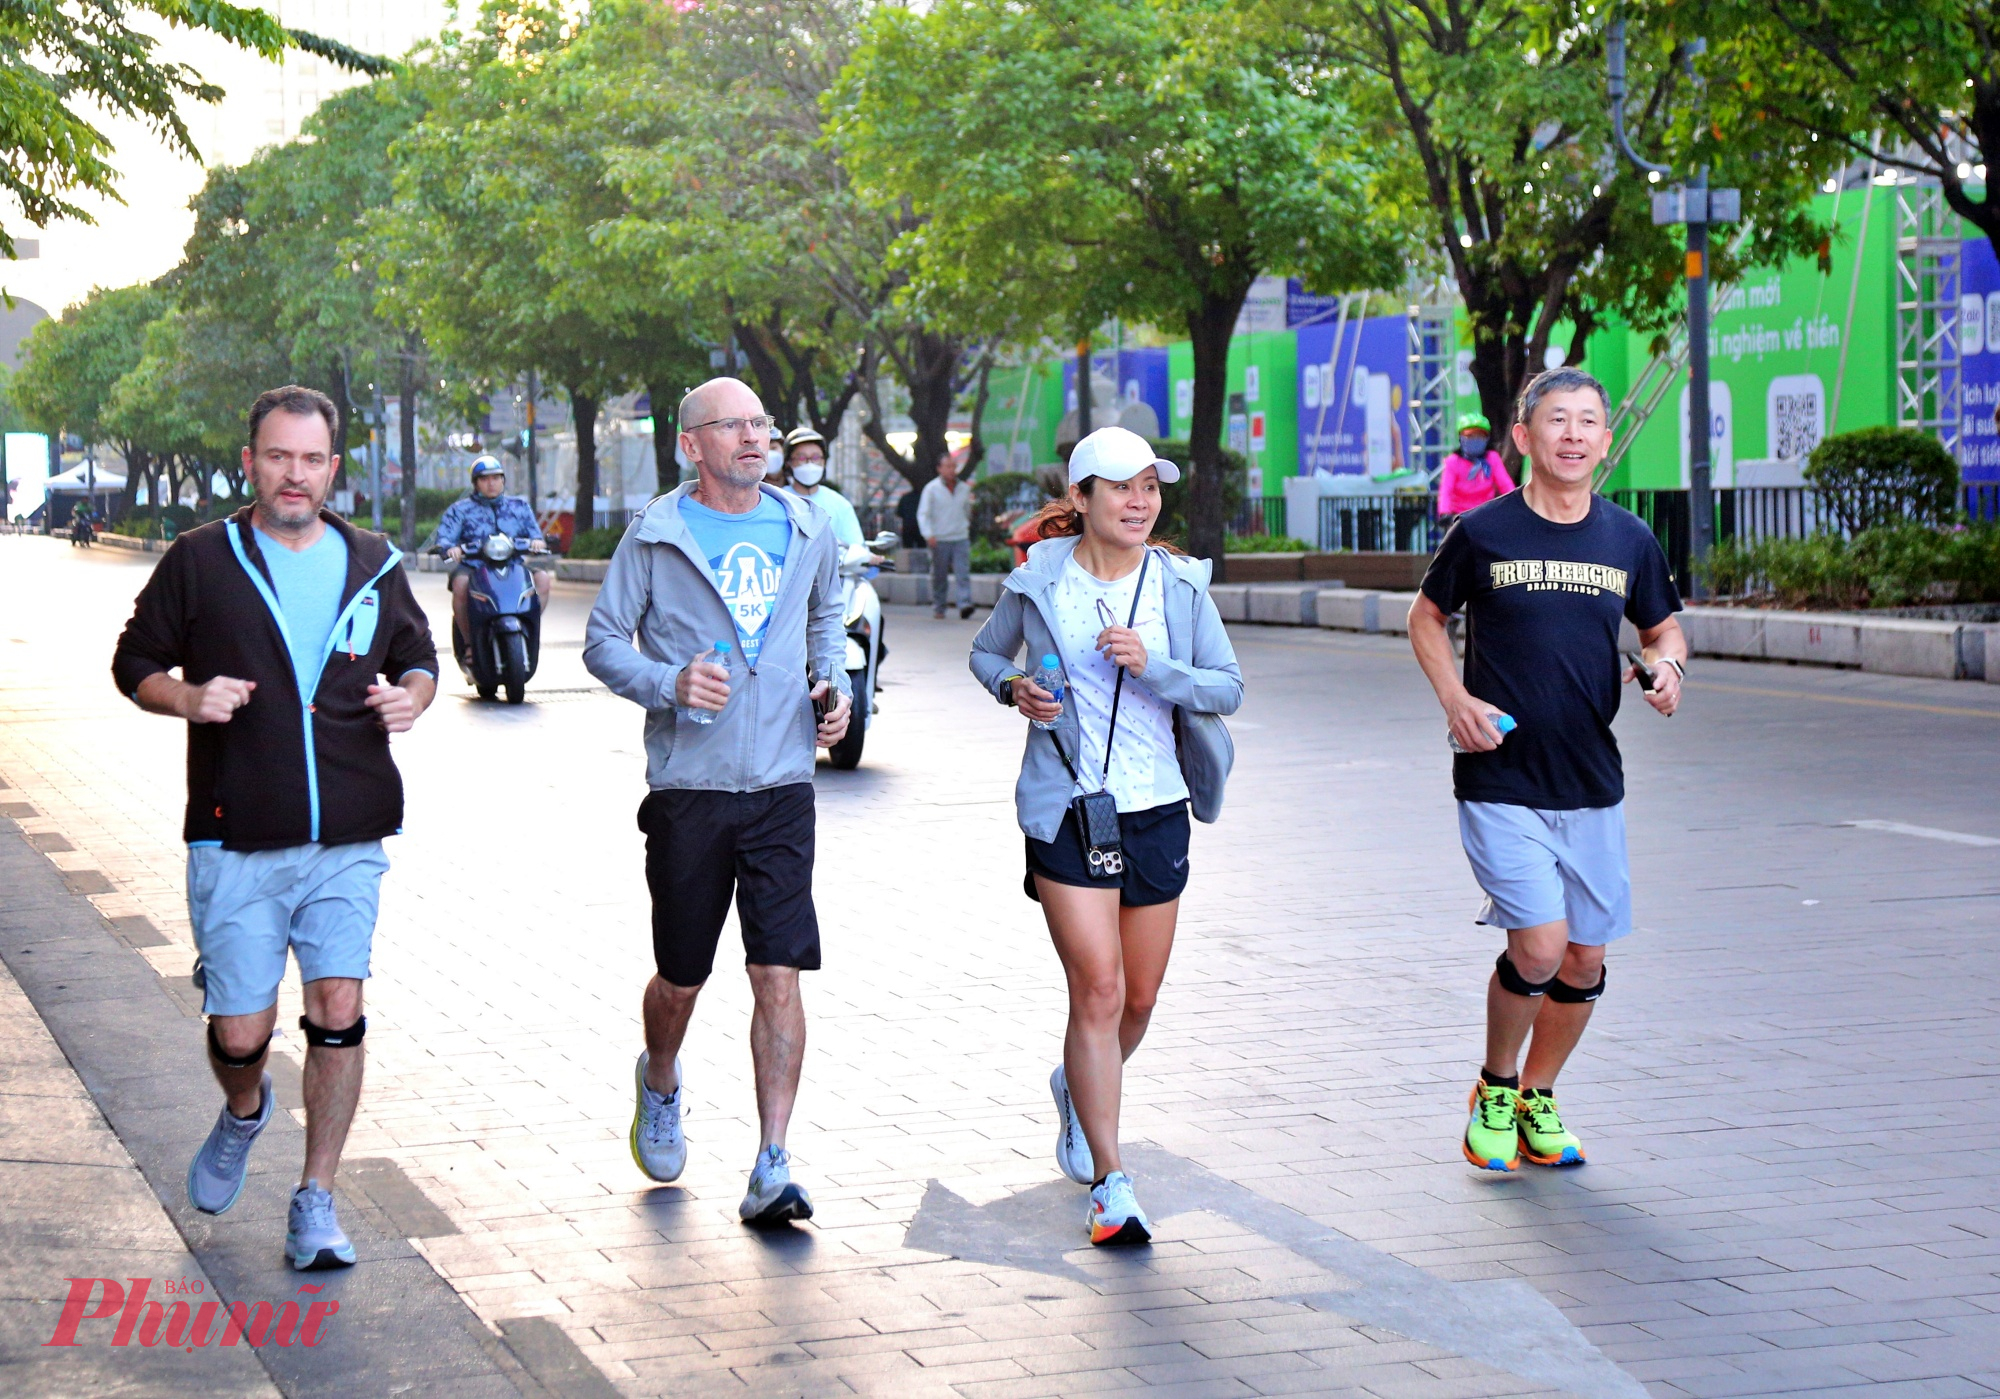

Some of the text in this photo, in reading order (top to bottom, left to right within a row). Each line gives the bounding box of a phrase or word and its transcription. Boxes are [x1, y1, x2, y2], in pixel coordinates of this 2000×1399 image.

[1721, 324, 1780, 363] nghiệm
[1490, 560, 1628, 599] TRUE RELIGION
[1526, 582, 1559, 592] BRAND
[740, 603, 763, 617] 5K
